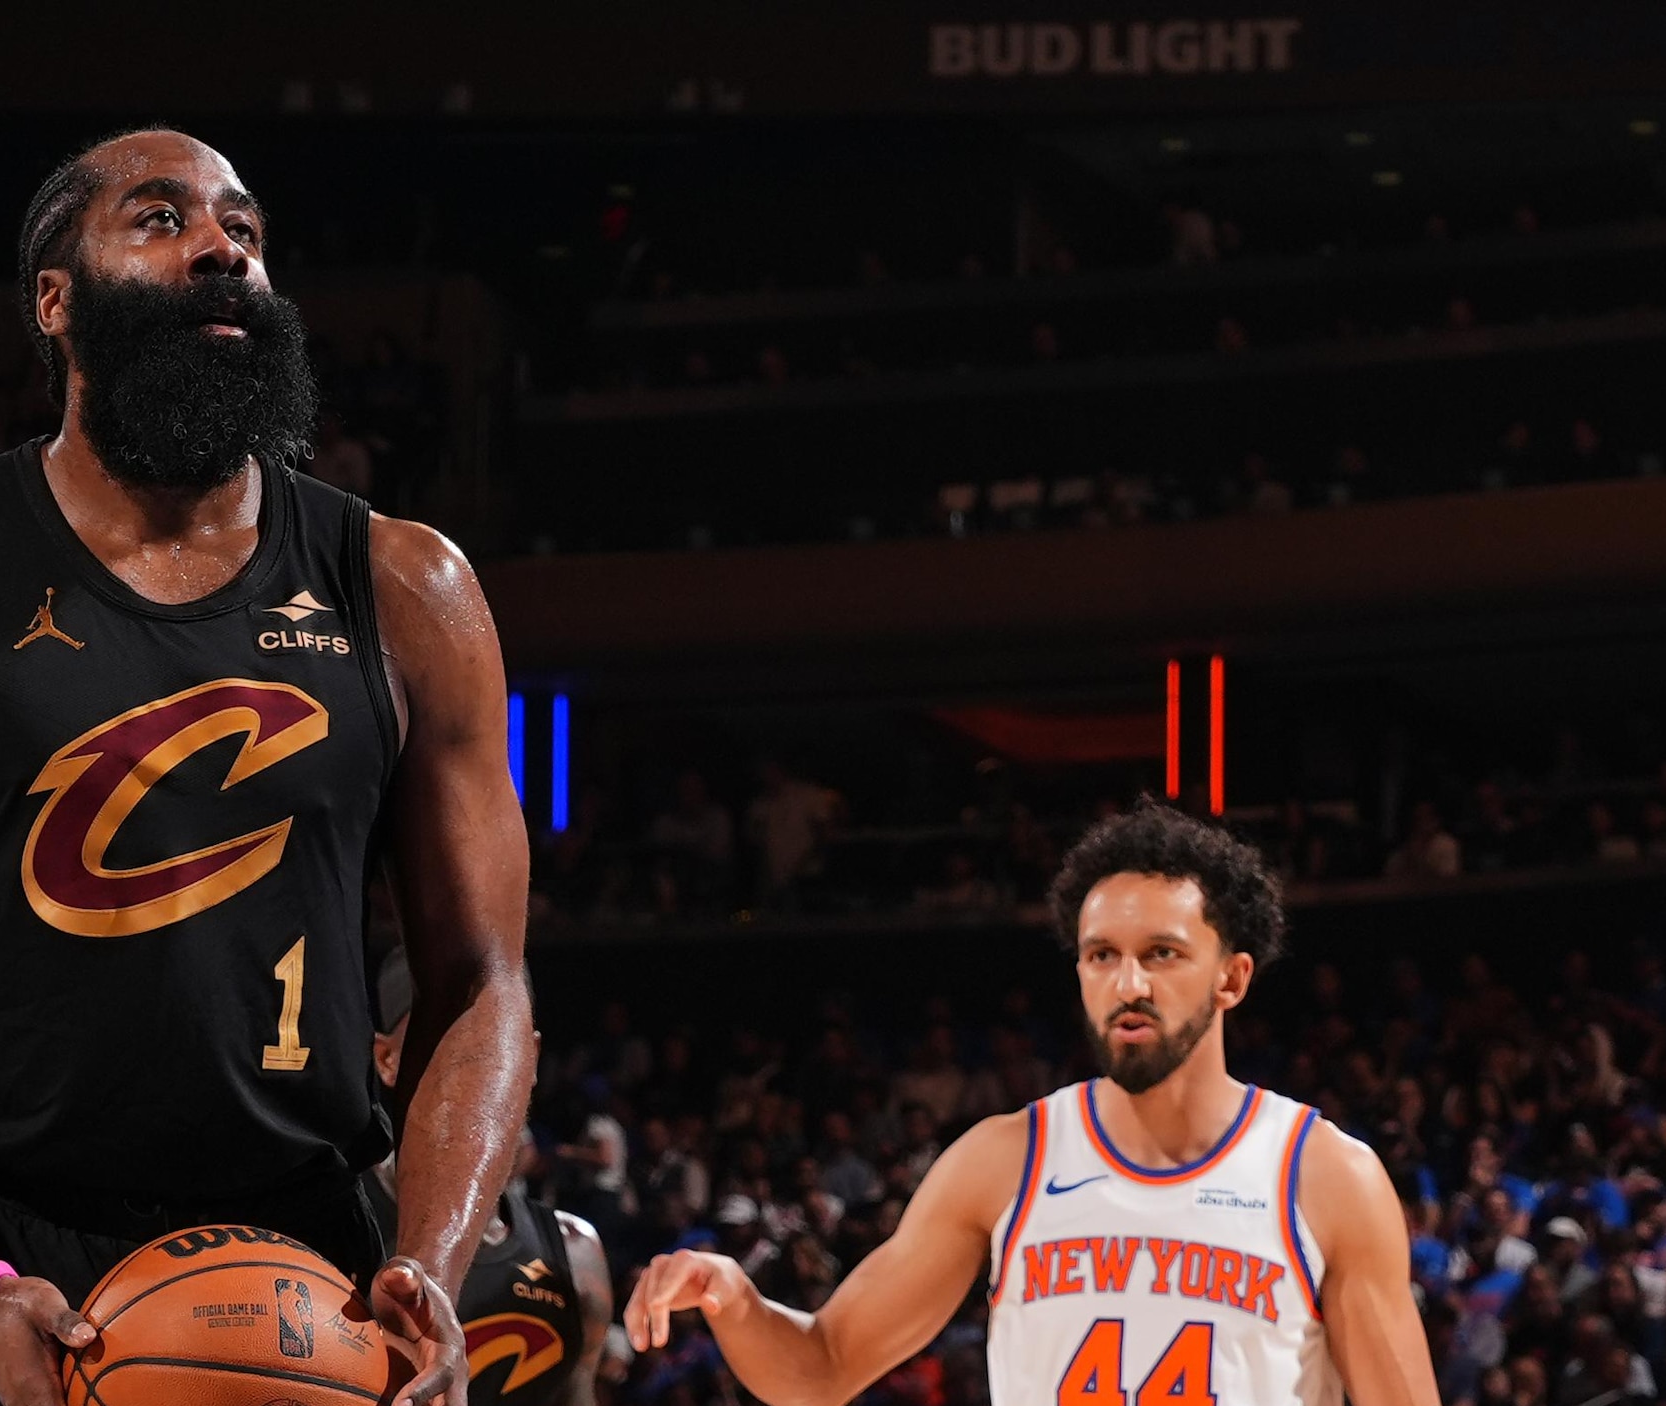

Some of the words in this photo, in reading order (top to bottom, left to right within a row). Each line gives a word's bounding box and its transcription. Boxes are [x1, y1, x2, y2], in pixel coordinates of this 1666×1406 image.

[931, 23, 1082, 76] BUD
[1089, 18, 1302, 75] LIGHT
[258, 629, 351, 655] CLIFFS
[262, 935, 311, 1071] 1
[1023, 1236, 1140, 1303] NEW
[1145, 1238, 1285, 1323] YORK
[193, 1304, 226, 1319] OFFICIAL
[228, 1303, 250, 1317] GAME
[250, 1302, 269, 1316] BALL
